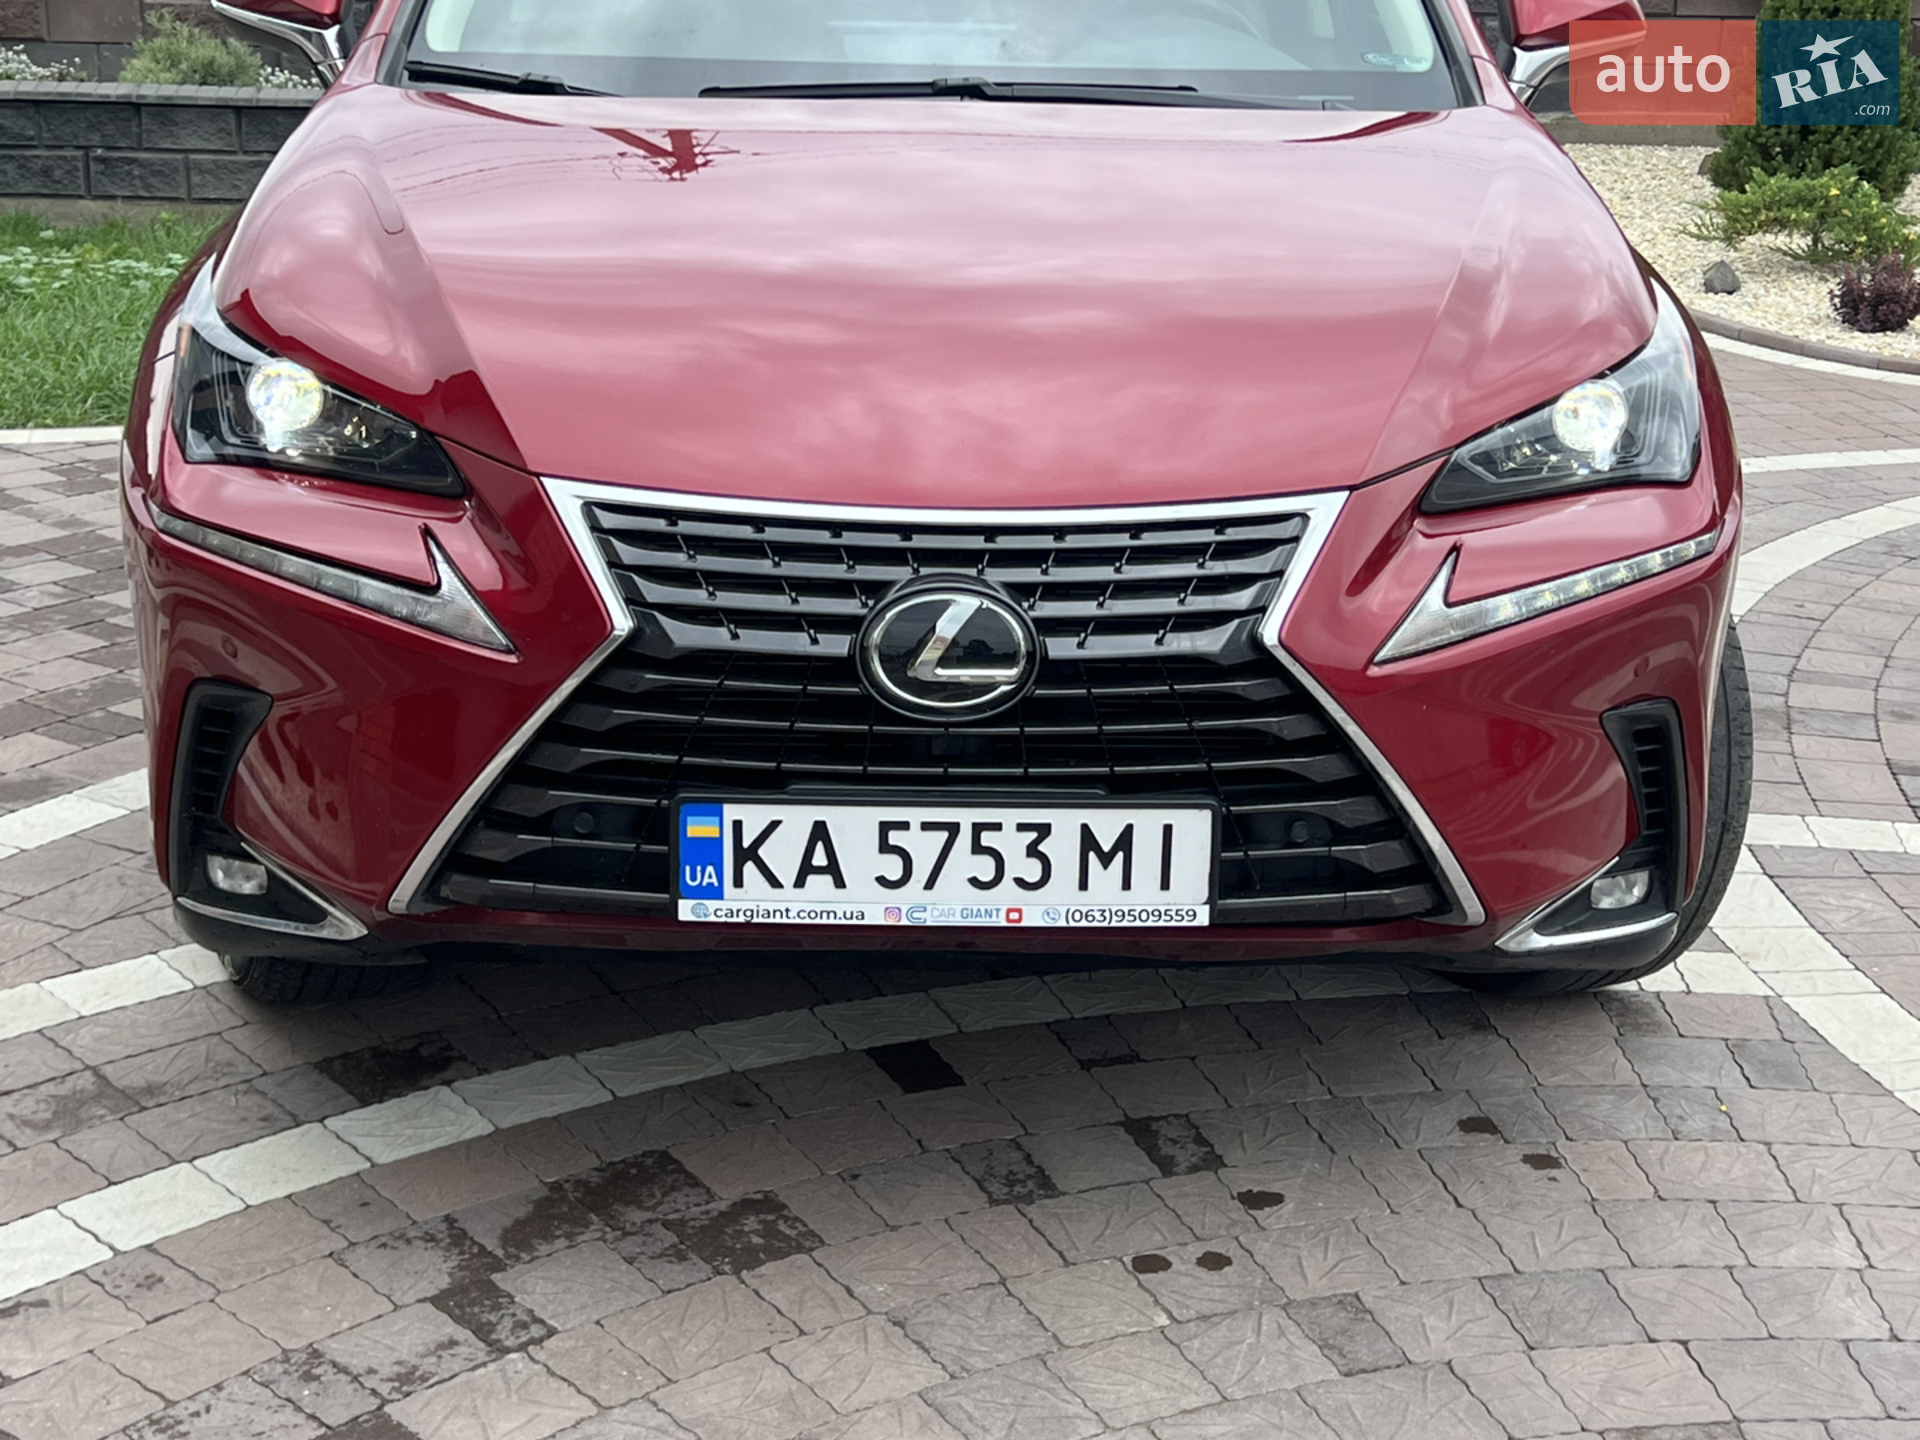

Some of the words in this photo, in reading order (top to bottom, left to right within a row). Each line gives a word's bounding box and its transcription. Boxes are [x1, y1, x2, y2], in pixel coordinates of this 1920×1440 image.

[732, 819, 847, 890] KA
[874, 821, 1052, 891] 5753
[1078, 823, 1173, 891] MI
[685, 865, 719, 887] UA
[713, 904, 866, 923] cargiant.com.ua
[930, 908, 957, 920] CAR
[960, 908, 1001, 921] GIANT
[1064, 908, 1198, 925] (063)9509559
